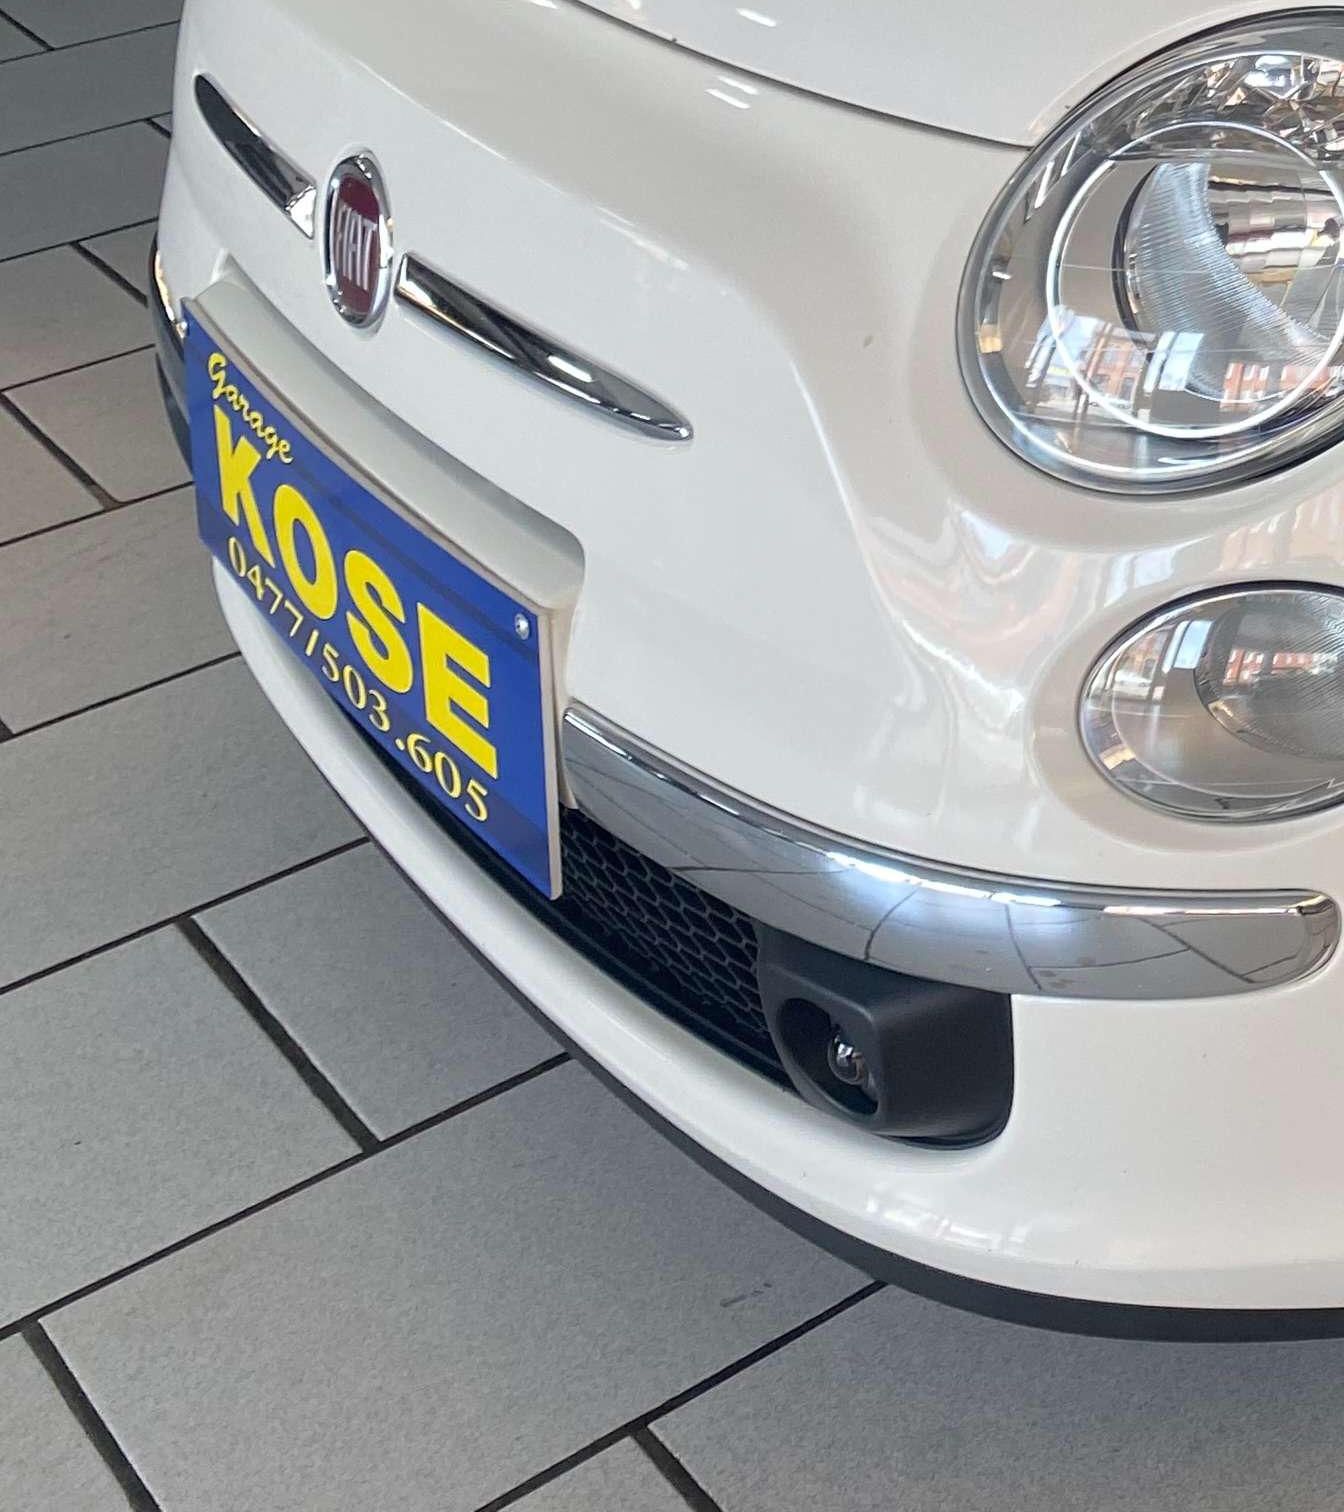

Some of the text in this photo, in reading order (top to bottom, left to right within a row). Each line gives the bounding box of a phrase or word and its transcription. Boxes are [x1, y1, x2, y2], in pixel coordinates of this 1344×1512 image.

[336, 202, 378, 291] FIAT
[208, 352, 294, 464] Garage
[213, 404, 499, 780] KOSE
